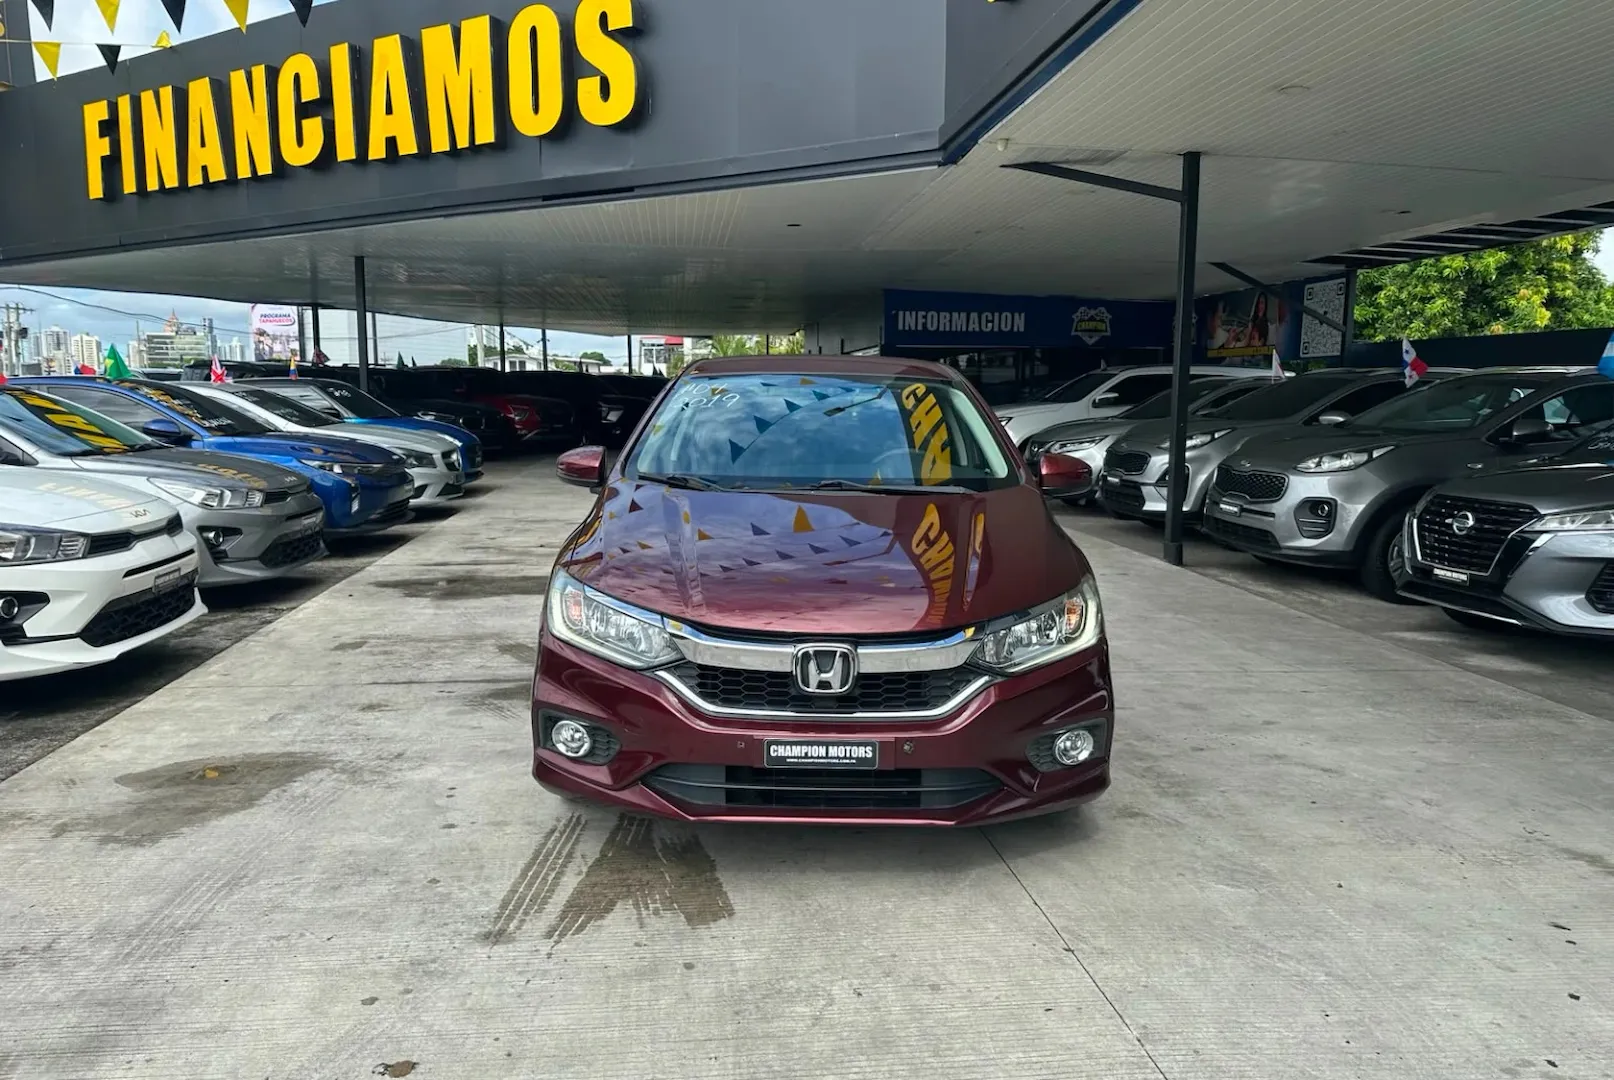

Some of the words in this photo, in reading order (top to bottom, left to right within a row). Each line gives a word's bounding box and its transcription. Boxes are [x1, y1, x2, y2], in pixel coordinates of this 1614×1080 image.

[82, 0, 636, 199] FINANCIAMOS
[896, 310, 1026, 333] INFORMACION
[769, 744, 826, 758] CHAMPION
[828, 745, 873, 758] MOTORS
